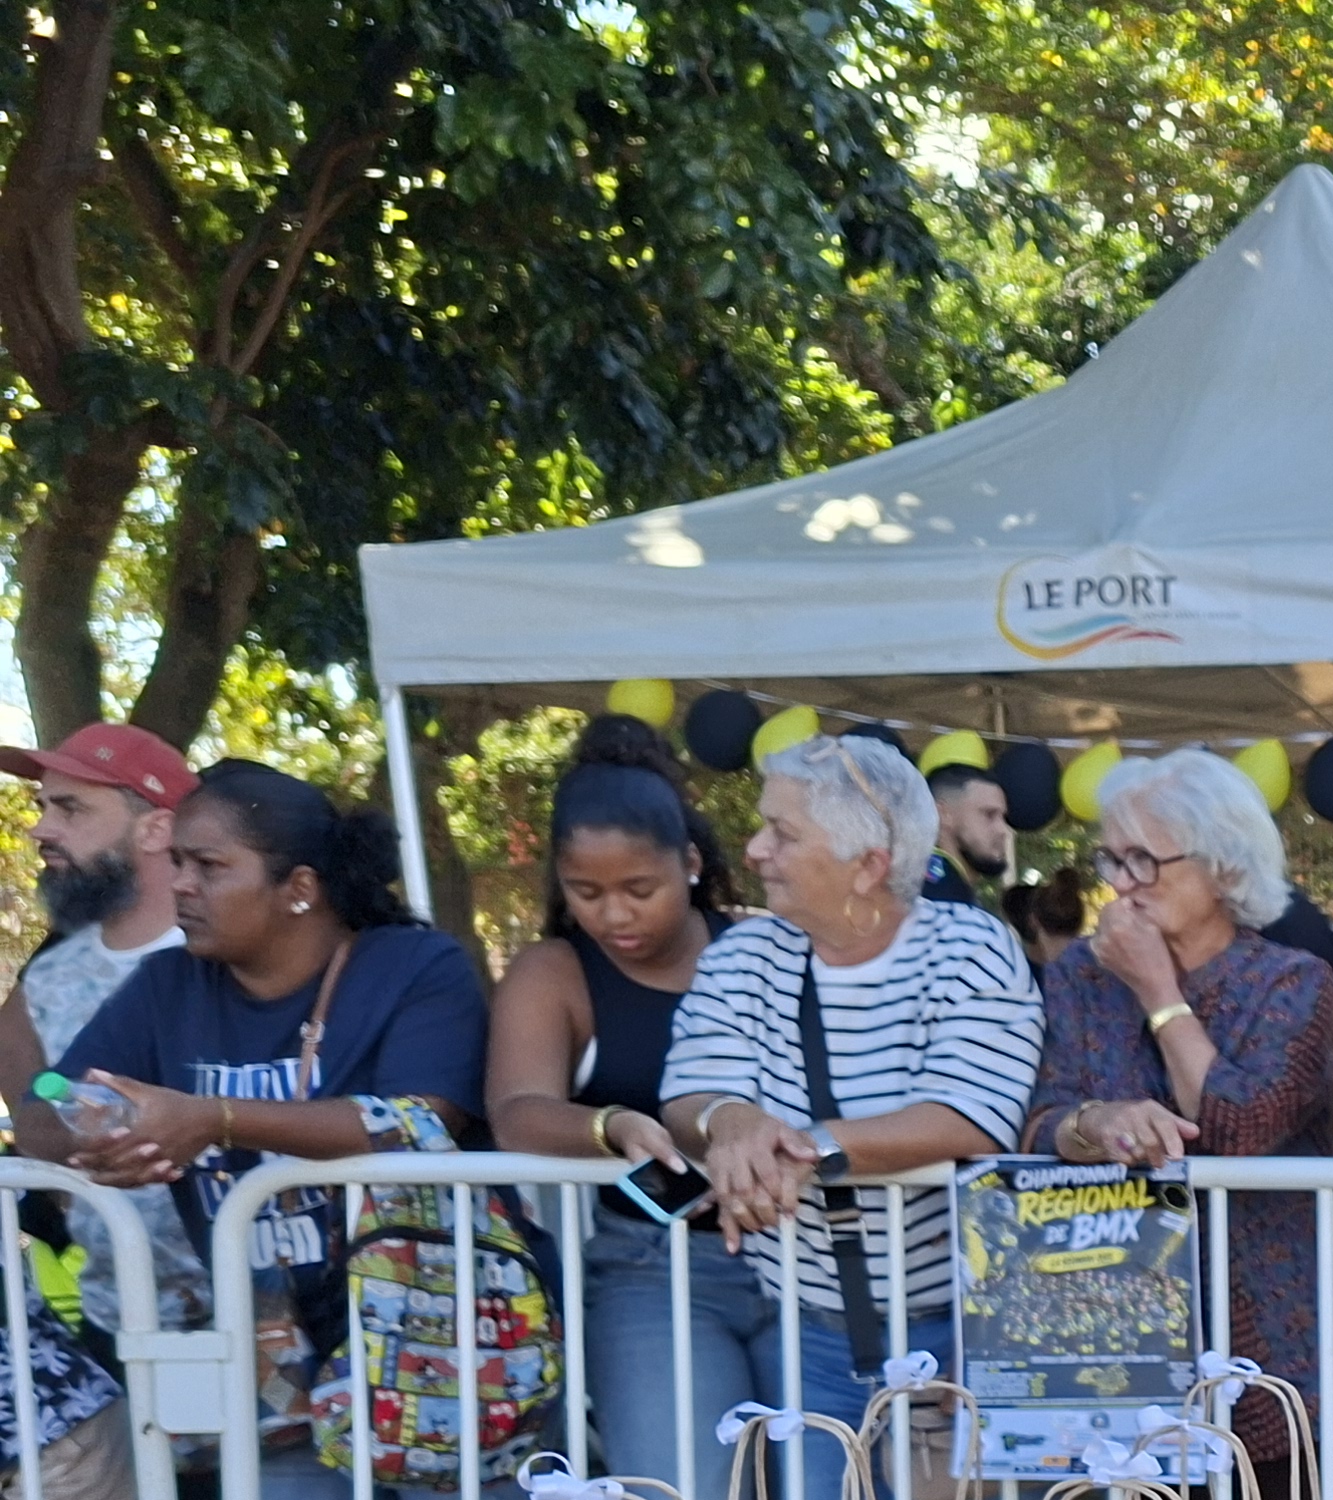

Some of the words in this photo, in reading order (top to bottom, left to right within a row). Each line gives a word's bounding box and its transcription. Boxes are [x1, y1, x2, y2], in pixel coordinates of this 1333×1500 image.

[1024, 579, 1065, 610] LE
[1075, 575, 1178, 607] PORT
[1014, 1163, 1128, 1190] CHAMPIONNAT
[1044, 1224, 1069, 1245] DE
[1069, 1207, 1145, 1250] BMX
